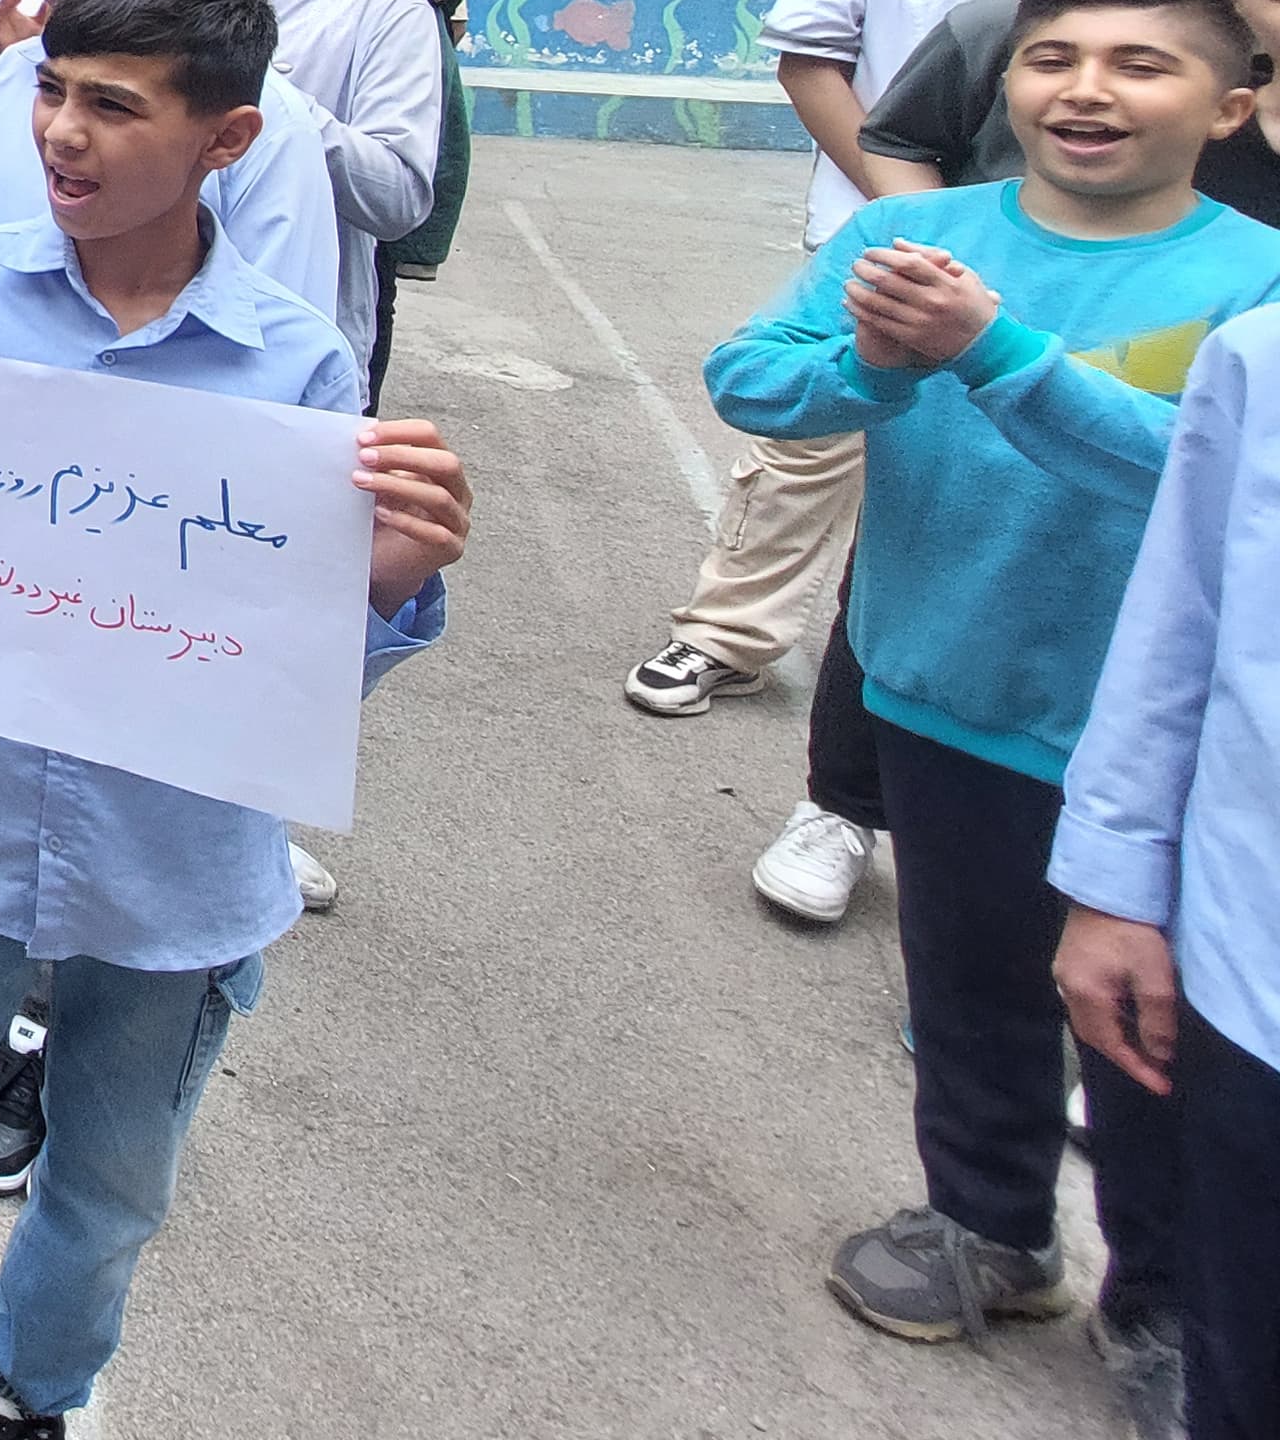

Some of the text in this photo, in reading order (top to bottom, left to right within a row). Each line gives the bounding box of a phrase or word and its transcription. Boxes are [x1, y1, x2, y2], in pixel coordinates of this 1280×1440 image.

[50, 464, 170, 534] عزیزم
[180, 478, 288, 570] معلم
[89, 593, 244, 662] دبیرستان
